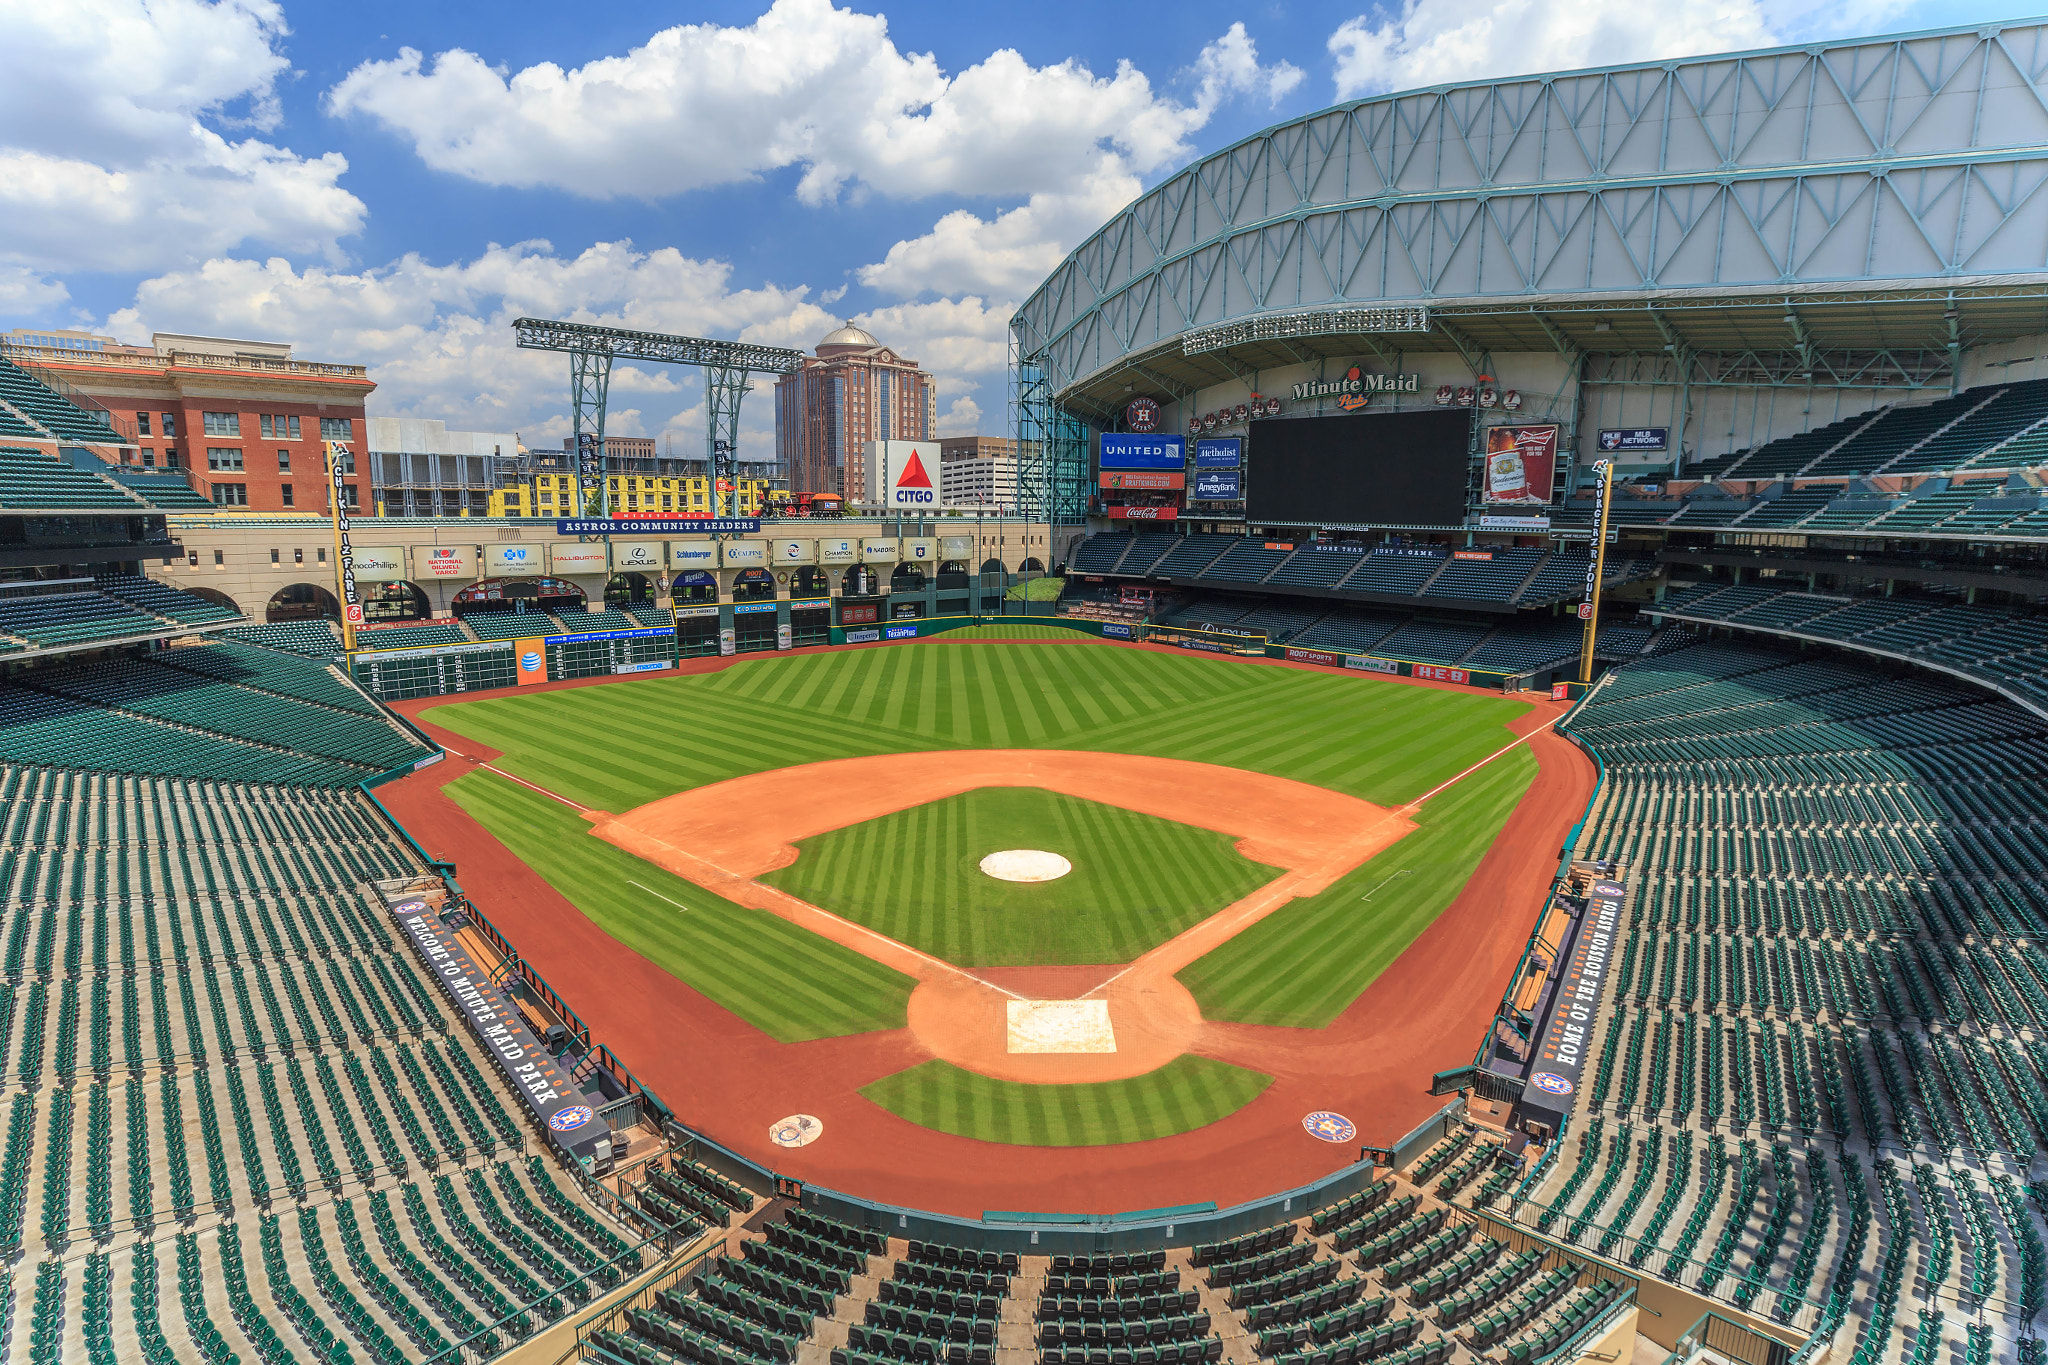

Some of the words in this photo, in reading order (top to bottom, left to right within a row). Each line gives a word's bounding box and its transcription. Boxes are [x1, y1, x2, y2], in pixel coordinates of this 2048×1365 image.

[1292, 378, 1362, 400] Minute
[1364, 373, 1419, 392] Maid
[1436, 385, 1452, 397] 49
[1457, 386, 1474, 398] 24
[1483, 387, 1494, 400] 5
[1507, 389, 1517, 402] 7
[1337, 393, 1368, 410] Park
[1106, 446, 1162, 455] UNITED
[1199, 447, 1237, 457] Methodist
[334, 467, 349, 530] CHIKIN
[896, 490, 933, 503] CITGO
[1591, 479, 1604, 547] BURGERZ
[622, 522, 699, 531] COMMUNITY
[704, 521, 754, 530] LEADERS
[676, 550, 711, 559] Schlumberger
[1590, 549, 1598, 559] R
[350, 561, 398, 570] onocoPhillips
[343, 557, 356, 603] FARE
[1585, 560, 1597, 602] FOUL
[1103, 625, 1129, 635] GEICO
[1215, 627, 1251, 636] LEXUS
[1289, 649, 1309, 658] ROOT
[1308, 653, 1333, 661] SPORTS
[1364, 661, 1379, 669] AIR
[1596, 900, 1619, 932] ASTROS
[1583, 931, 1610, 978] HOUSTON
[1575, 978, 1598, 1002] THE
[406, 915, 450, 961] WELCOME
[439, 960, 461, 976] TO
[450, 976, 497, 1023] MINUTE
[484, 1023, 524, 1060] MAID
[514, 1061, 558, 1105] PARK
[1569, 1002, 1590, 1021] OF
[1543, 1003, 1570, 1059] WELCOME
[1556, 1023, 1585, 1066] HOME
[523, 1043, 571, 1097] ASTROS
